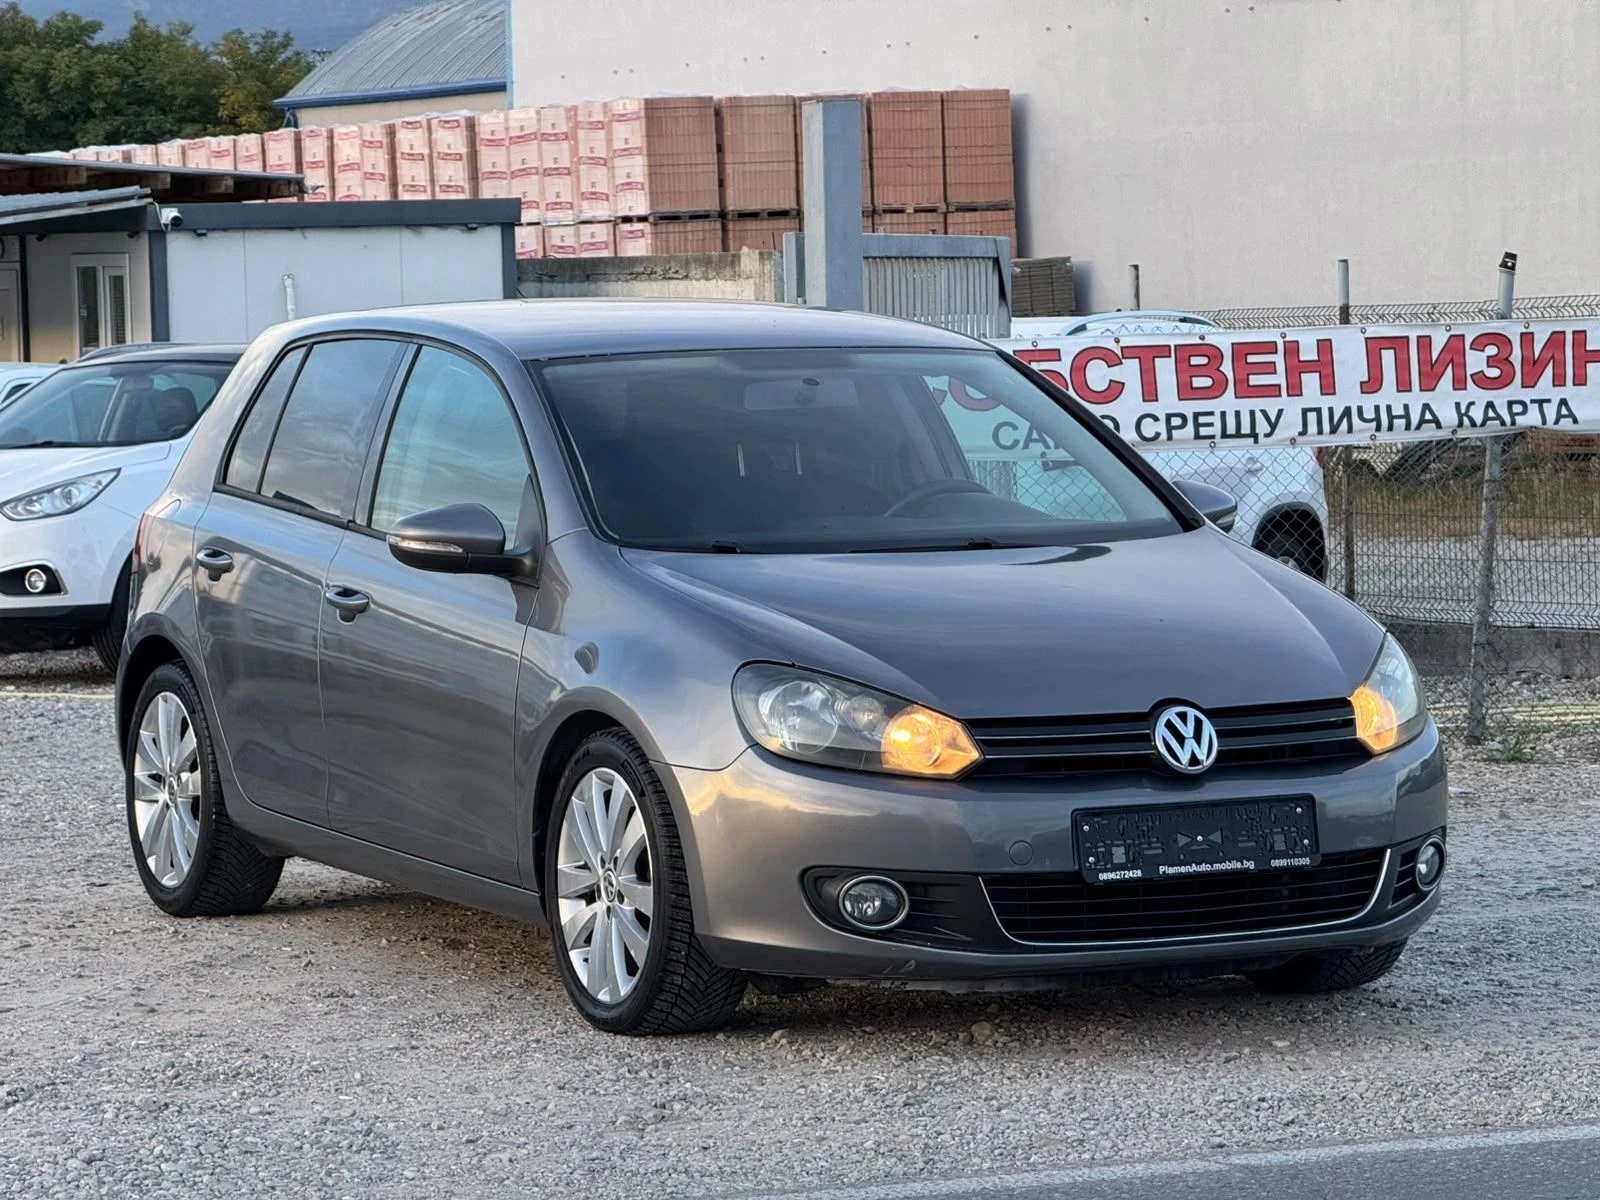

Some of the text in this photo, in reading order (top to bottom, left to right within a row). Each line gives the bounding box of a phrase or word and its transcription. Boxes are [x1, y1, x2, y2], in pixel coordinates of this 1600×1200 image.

[932, 338, 1336, 411] БСТВЕН
[992, 398, 1579, 450] СА СРЕЩУ ЛИЧНА КАРТА
[1156, 707, 1217, 769] VW
[1098, 857, 1310, 881] 0896272428 PlamenAuto.mobile.bg 0899110305
